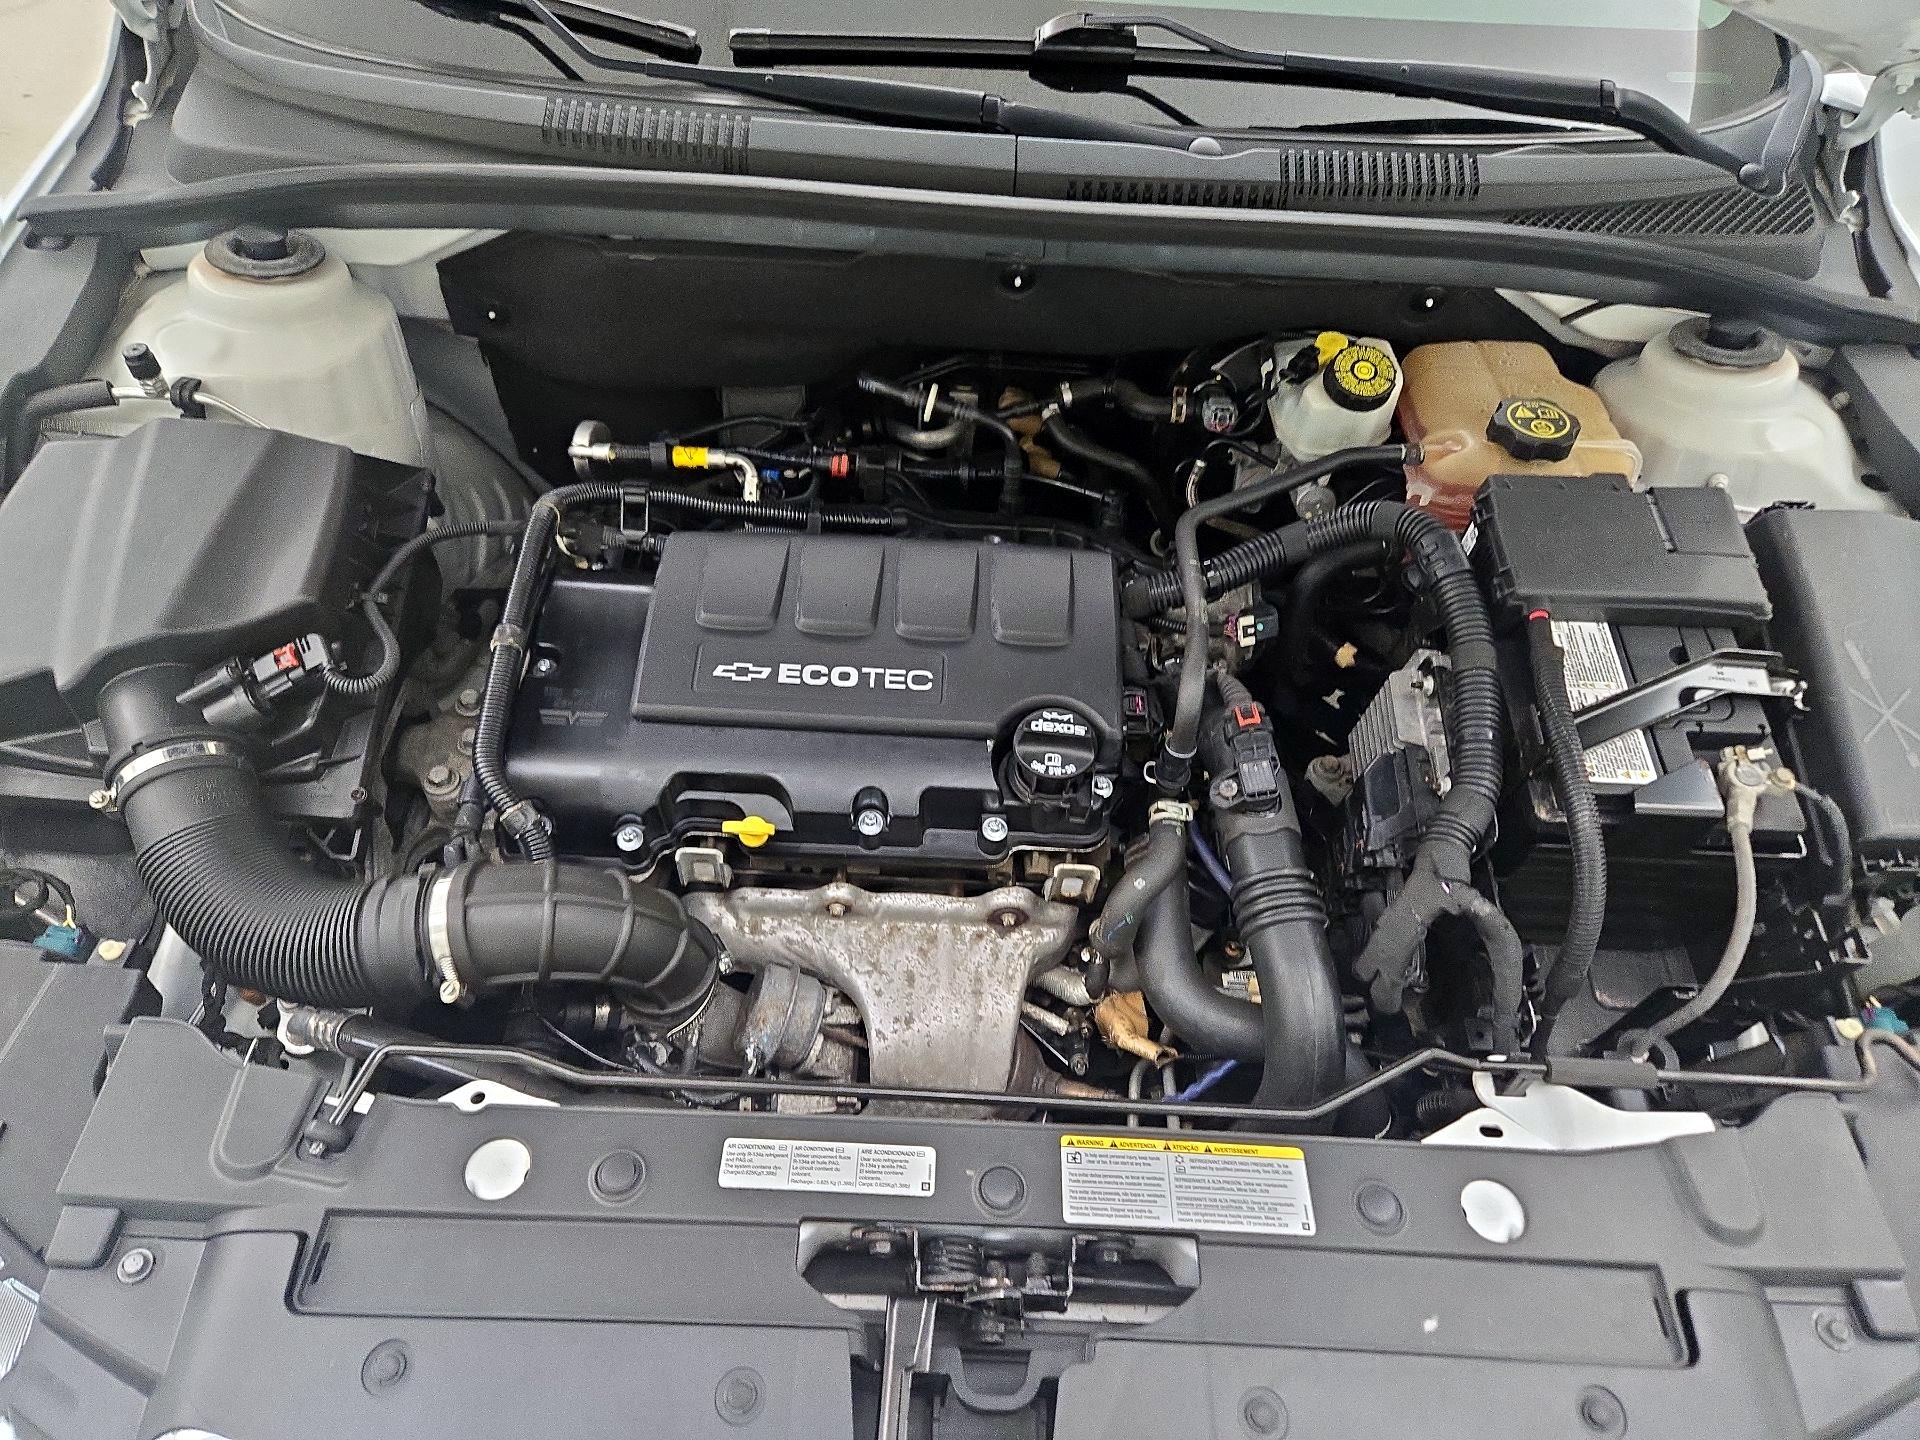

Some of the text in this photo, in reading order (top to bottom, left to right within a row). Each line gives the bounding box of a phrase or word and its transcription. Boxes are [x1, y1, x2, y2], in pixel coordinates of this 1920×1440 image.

[777, 662, 934, 691] ECOTEC
[1031, 719, 1087, 736] dexos
[874, 1149, 915, 1157] ACONDICIONADO
